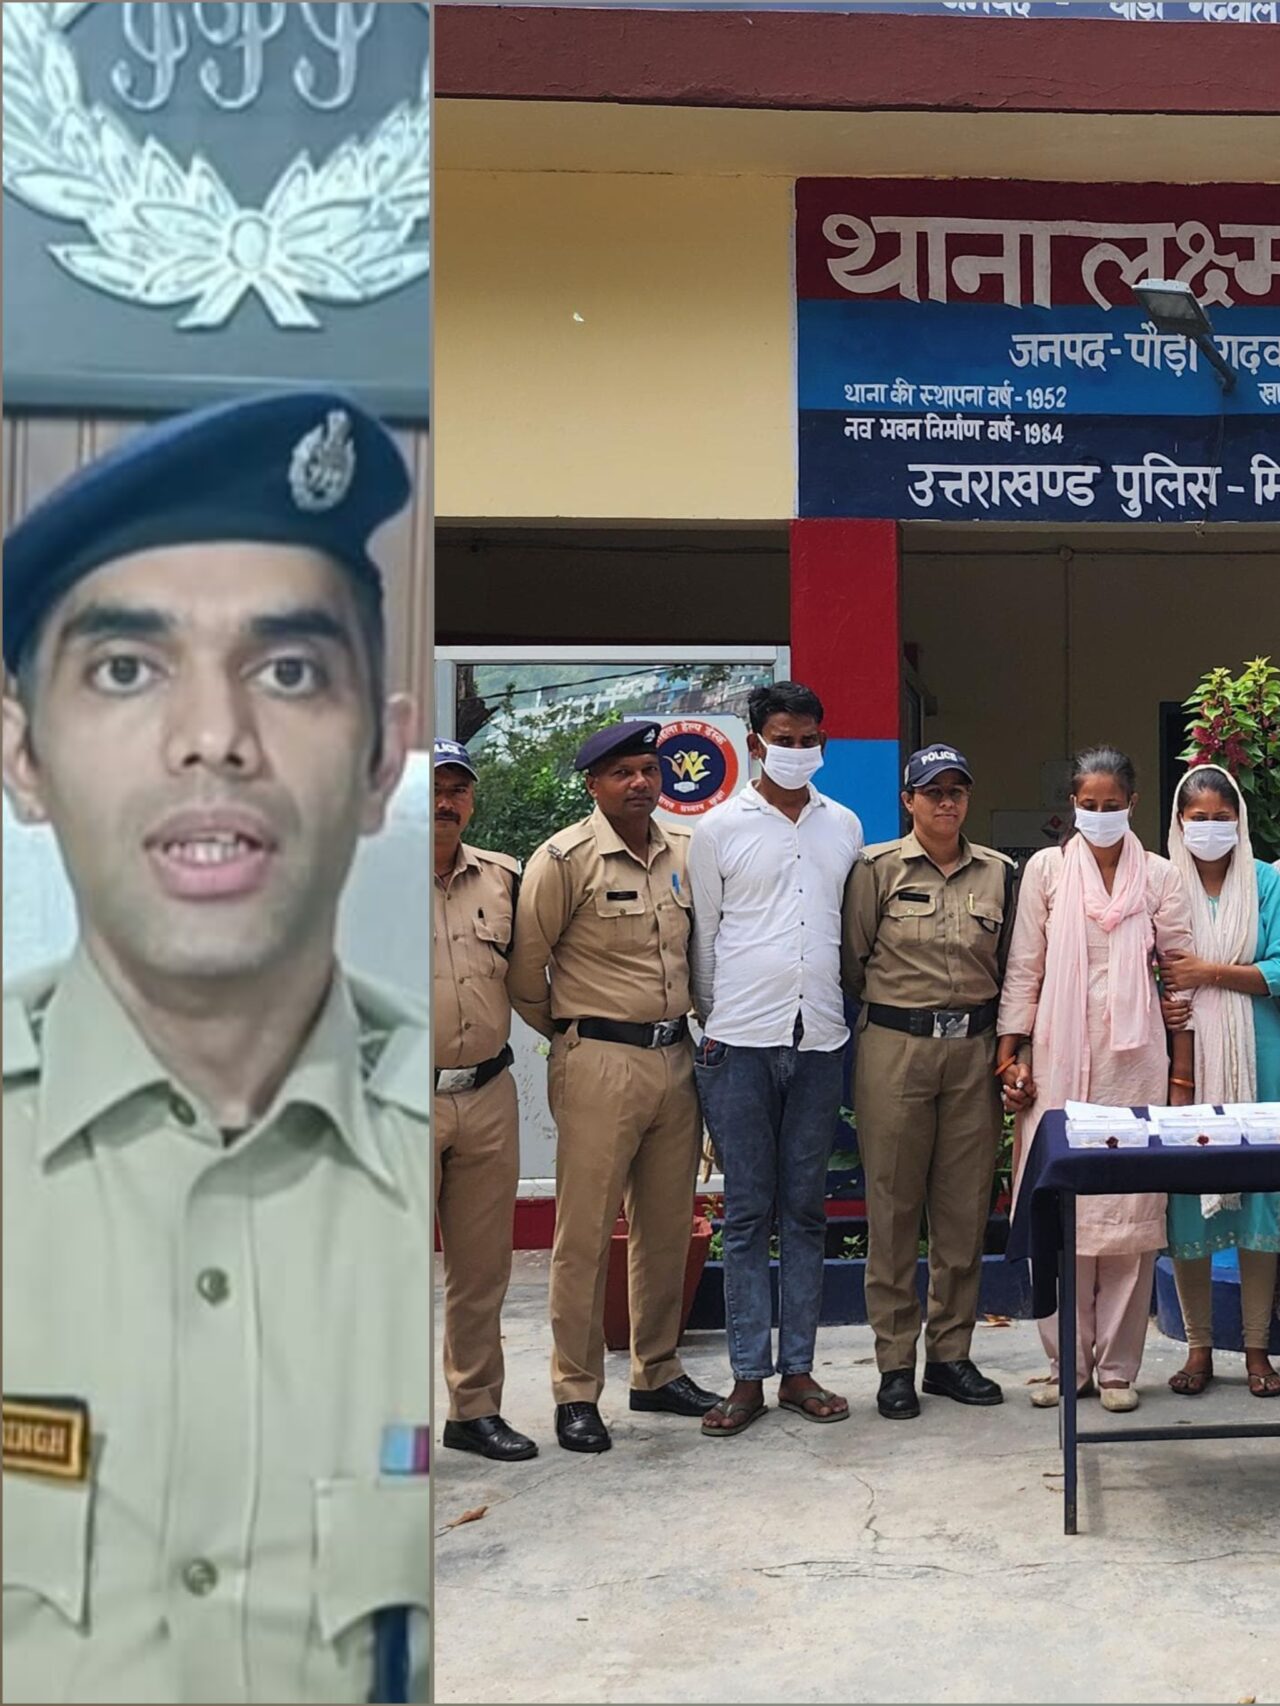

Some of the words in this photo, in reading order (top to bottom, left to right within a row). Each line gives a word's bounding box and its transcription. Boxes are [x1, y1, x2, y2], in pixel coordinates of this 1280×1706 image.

[822, 213, 1052, 310] थाना
[844, 384, 888, 405] थाना
[890, 377, 916, 406] की
[919, 385, 984, 410] स्थापना
[844, 417, 875, 442] नव
[880, 417, 923, 442] भवन
[924, 413, 985, 442] निर्माण
[908, 463, 1101, 509] उत्तराखण्ड
[1112, 452, 1223, 520] पुलिस
[920, 750, 959, 766] POLICE
[3, 1420, 67, 1456] INGH
